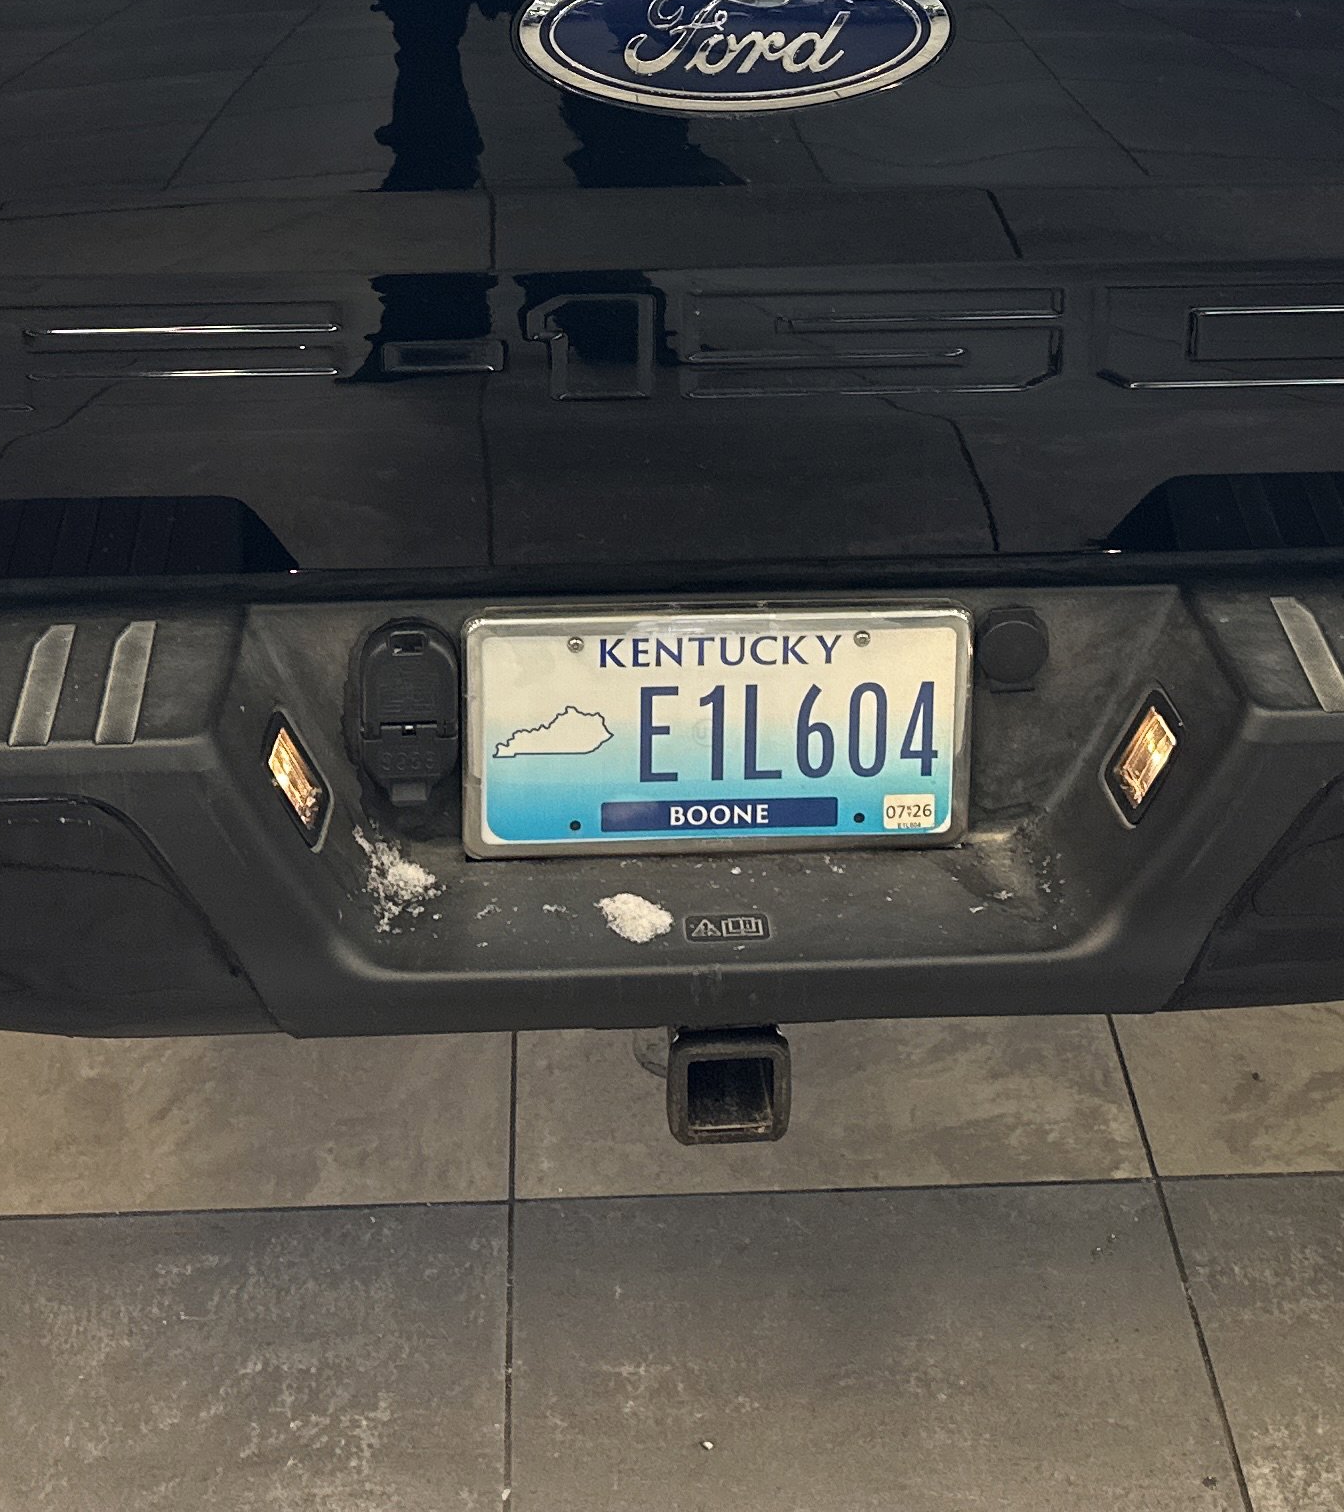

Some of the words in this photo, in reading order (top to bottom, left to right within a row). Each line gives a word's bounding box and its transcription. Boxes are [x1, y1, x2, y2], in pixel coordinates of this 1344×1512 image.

[598, 634, 842, 669] KENTUCKY
[638, 681, 939, 783] E1L604
[669, 804, 770, 827] BOONE
